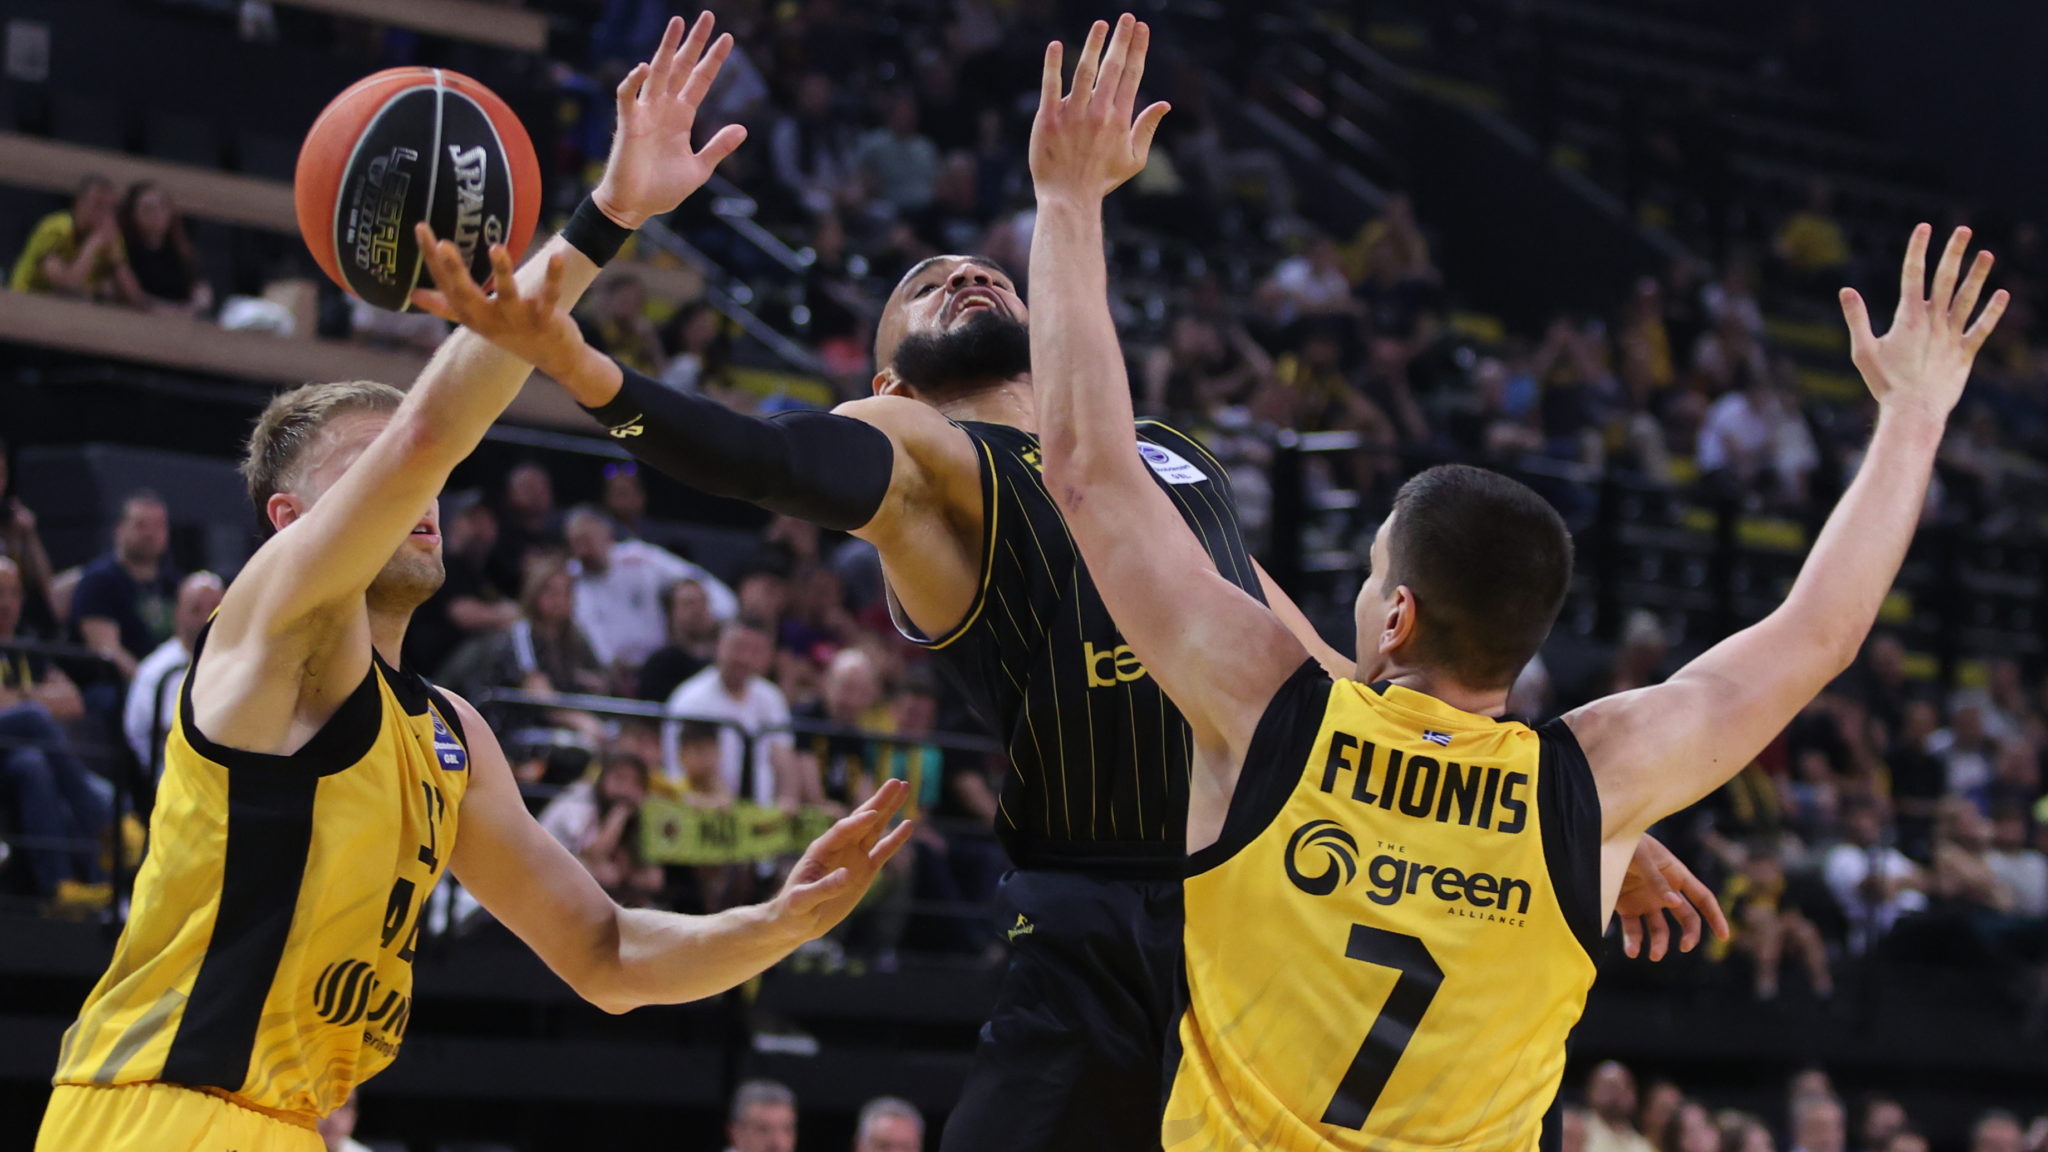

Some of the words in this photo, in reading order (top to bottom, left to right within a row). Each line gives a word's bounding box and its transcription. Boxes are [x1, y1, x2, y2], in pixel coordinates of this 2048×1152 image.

[448, 144, 487, 270] SPALD
[1320, 730, 1529, 834] FLIONIS
[1366, 854, 1532, 915] green
[1376, 840, 1406, 853] THE
[1447, 906, 1526, 928] ALLIANCE
[1320, 922, 1446, 1131] 7
